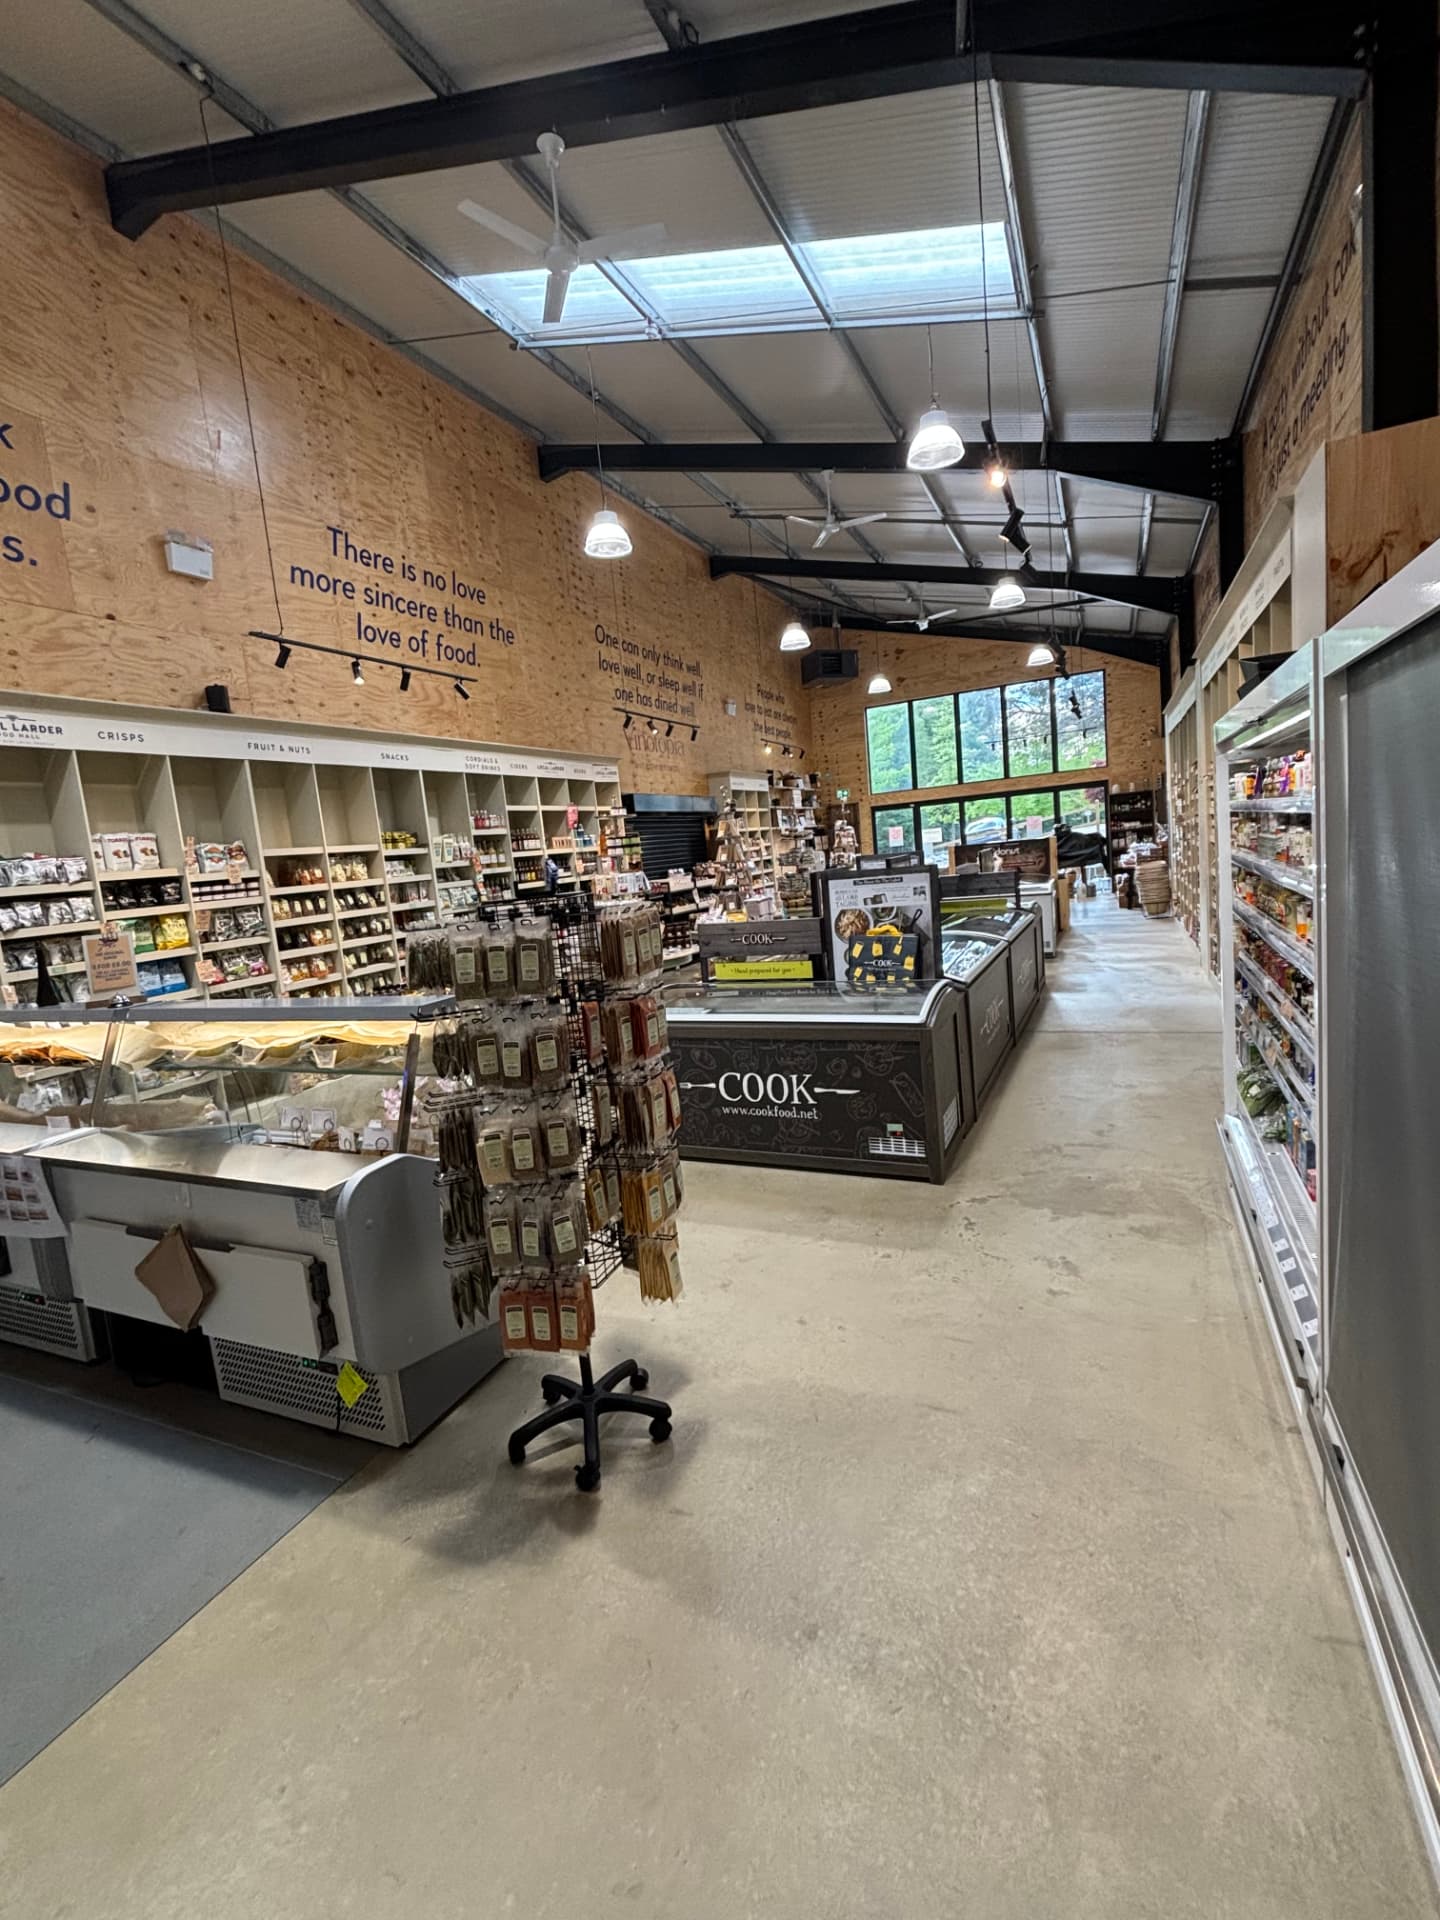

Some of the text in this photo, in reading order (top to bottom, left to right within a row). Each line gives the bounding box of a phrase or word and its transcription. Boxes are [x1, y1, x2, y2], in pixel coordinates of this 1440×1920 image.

[1291, 281, 1330, 391] without
[1300, 319, 1351, 432] meeting.
[326, 525, 486, 605] There is no love
[290, 565, 515, 645] more sincere than the
[357, 612, 481, 668] love of food.
[594, 623, 620, 650] One
[621, 638, 640, 657] can
[641, 643, 661, 669] only
[663, 652, 684, 673] think
[598, 650, 704, 702] love well, or sleep well if
[614, 687, 634, 704] one
[636, 689, 653, 708] has
[654, 691, 678, 714] dined
[12, 722, 64, 735] LARDER
[97, 731, 145, 743] CRISPS
[247, 742, 312, 755] FRUIT & NUTS
[380, 752, 410, 762] SNACKS
[742, 933, 773, 945] COOK
[718, 1072, 818, 1104] COOK
[721, 1105, 818, 1119] www.cookfood.net
